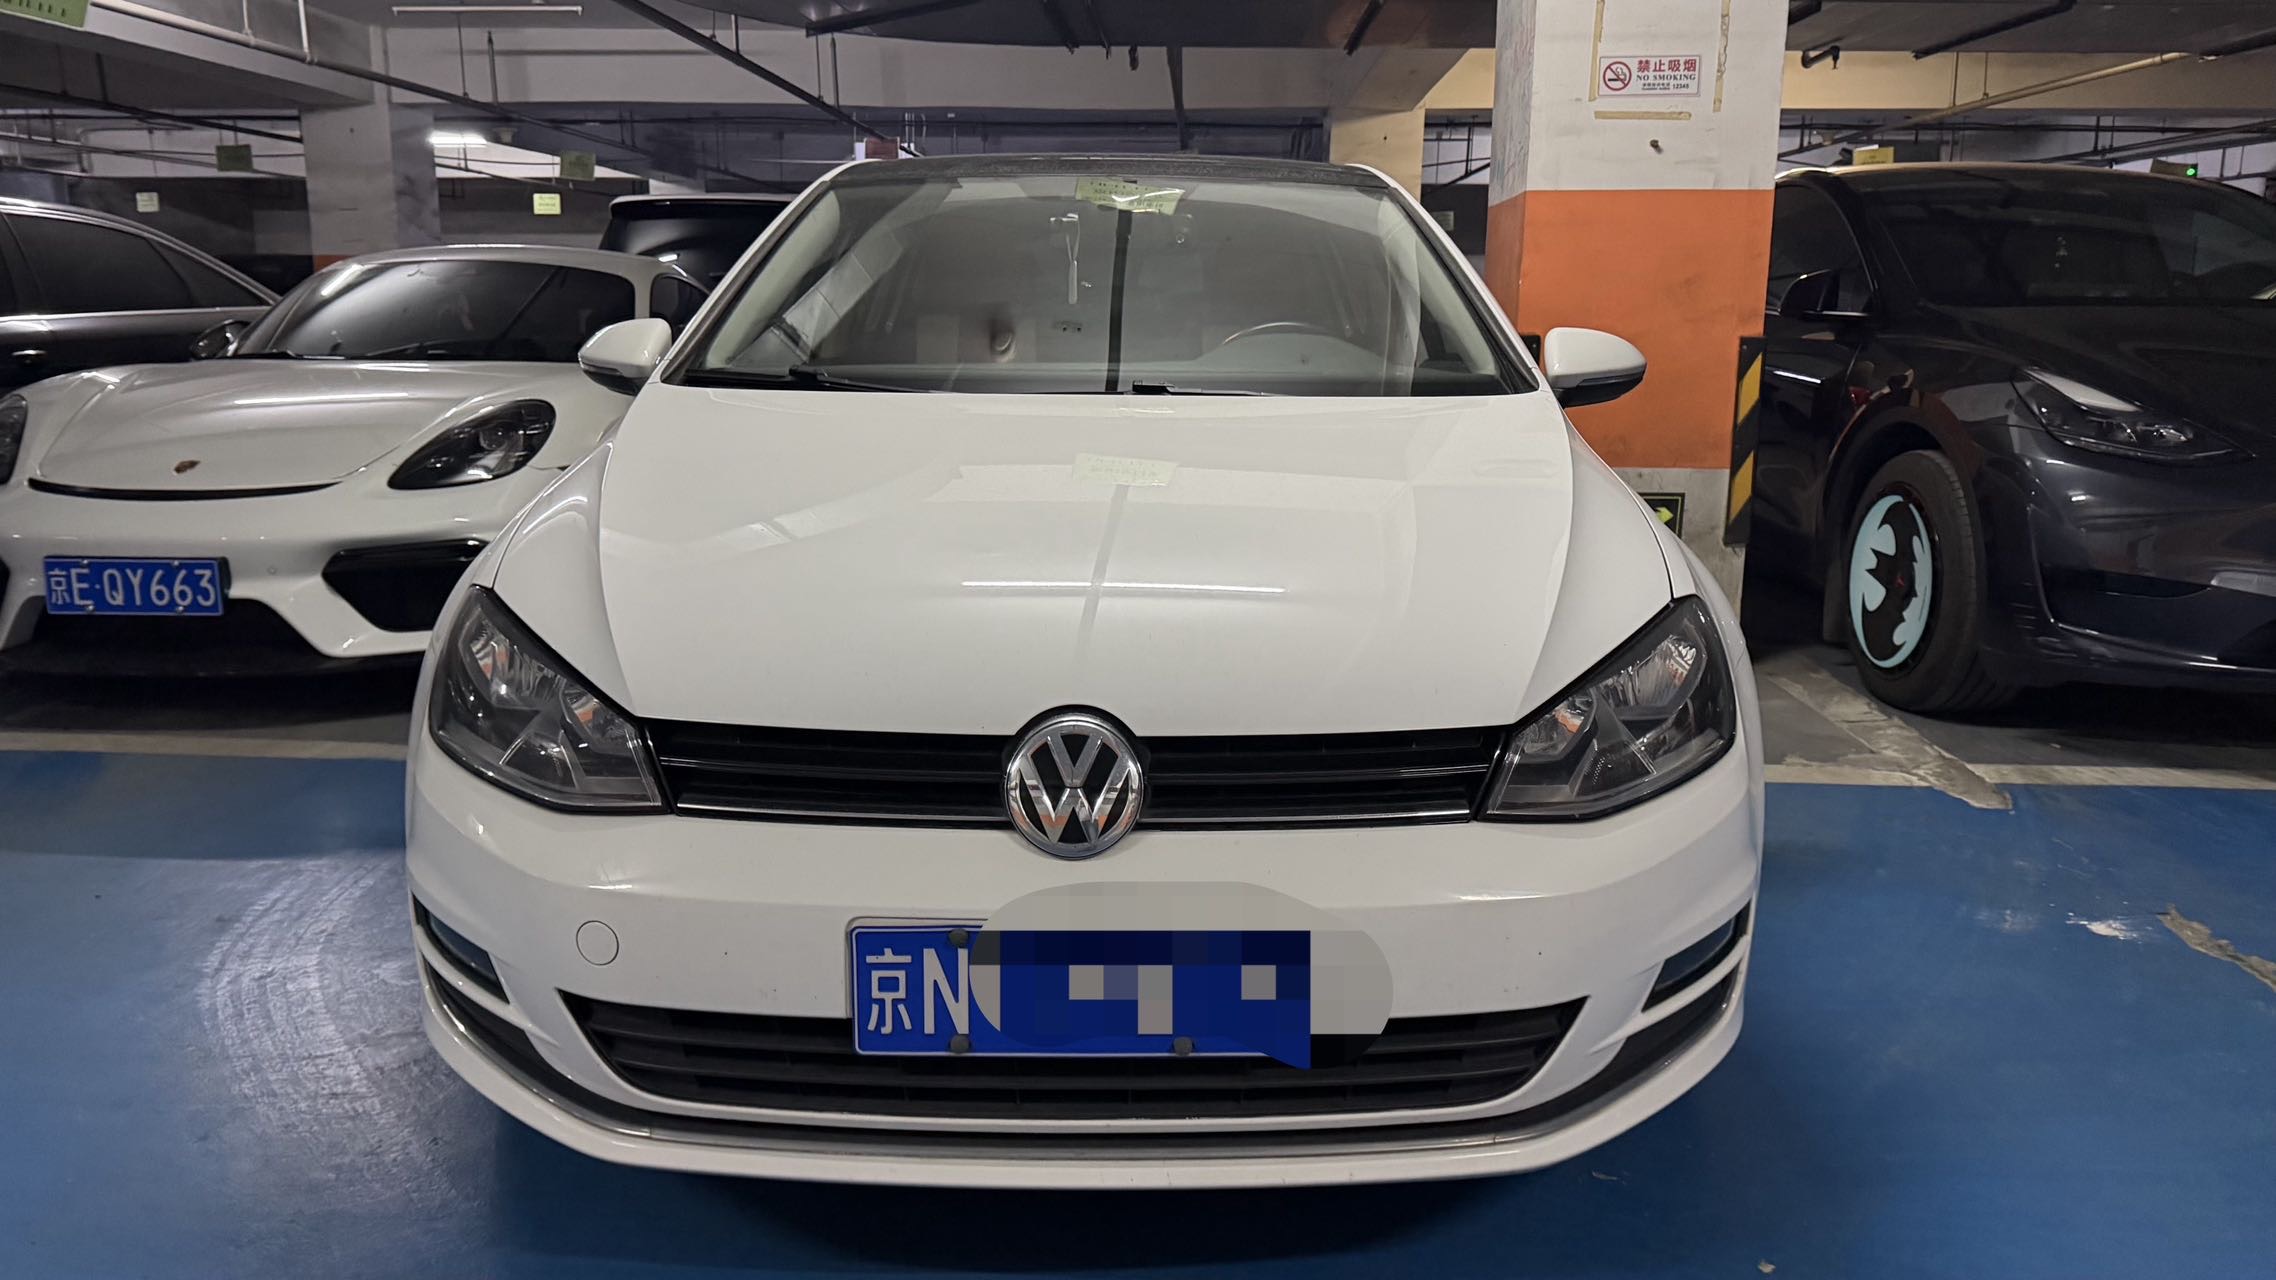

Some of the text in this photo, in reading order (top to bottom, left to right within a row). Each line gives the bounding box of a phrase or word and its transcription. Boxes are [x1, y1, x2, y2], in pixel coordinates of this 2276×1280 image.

[1636, 59, 1697, 73] 禁止吸烟
[1636, 74, 1650, 82] NO
